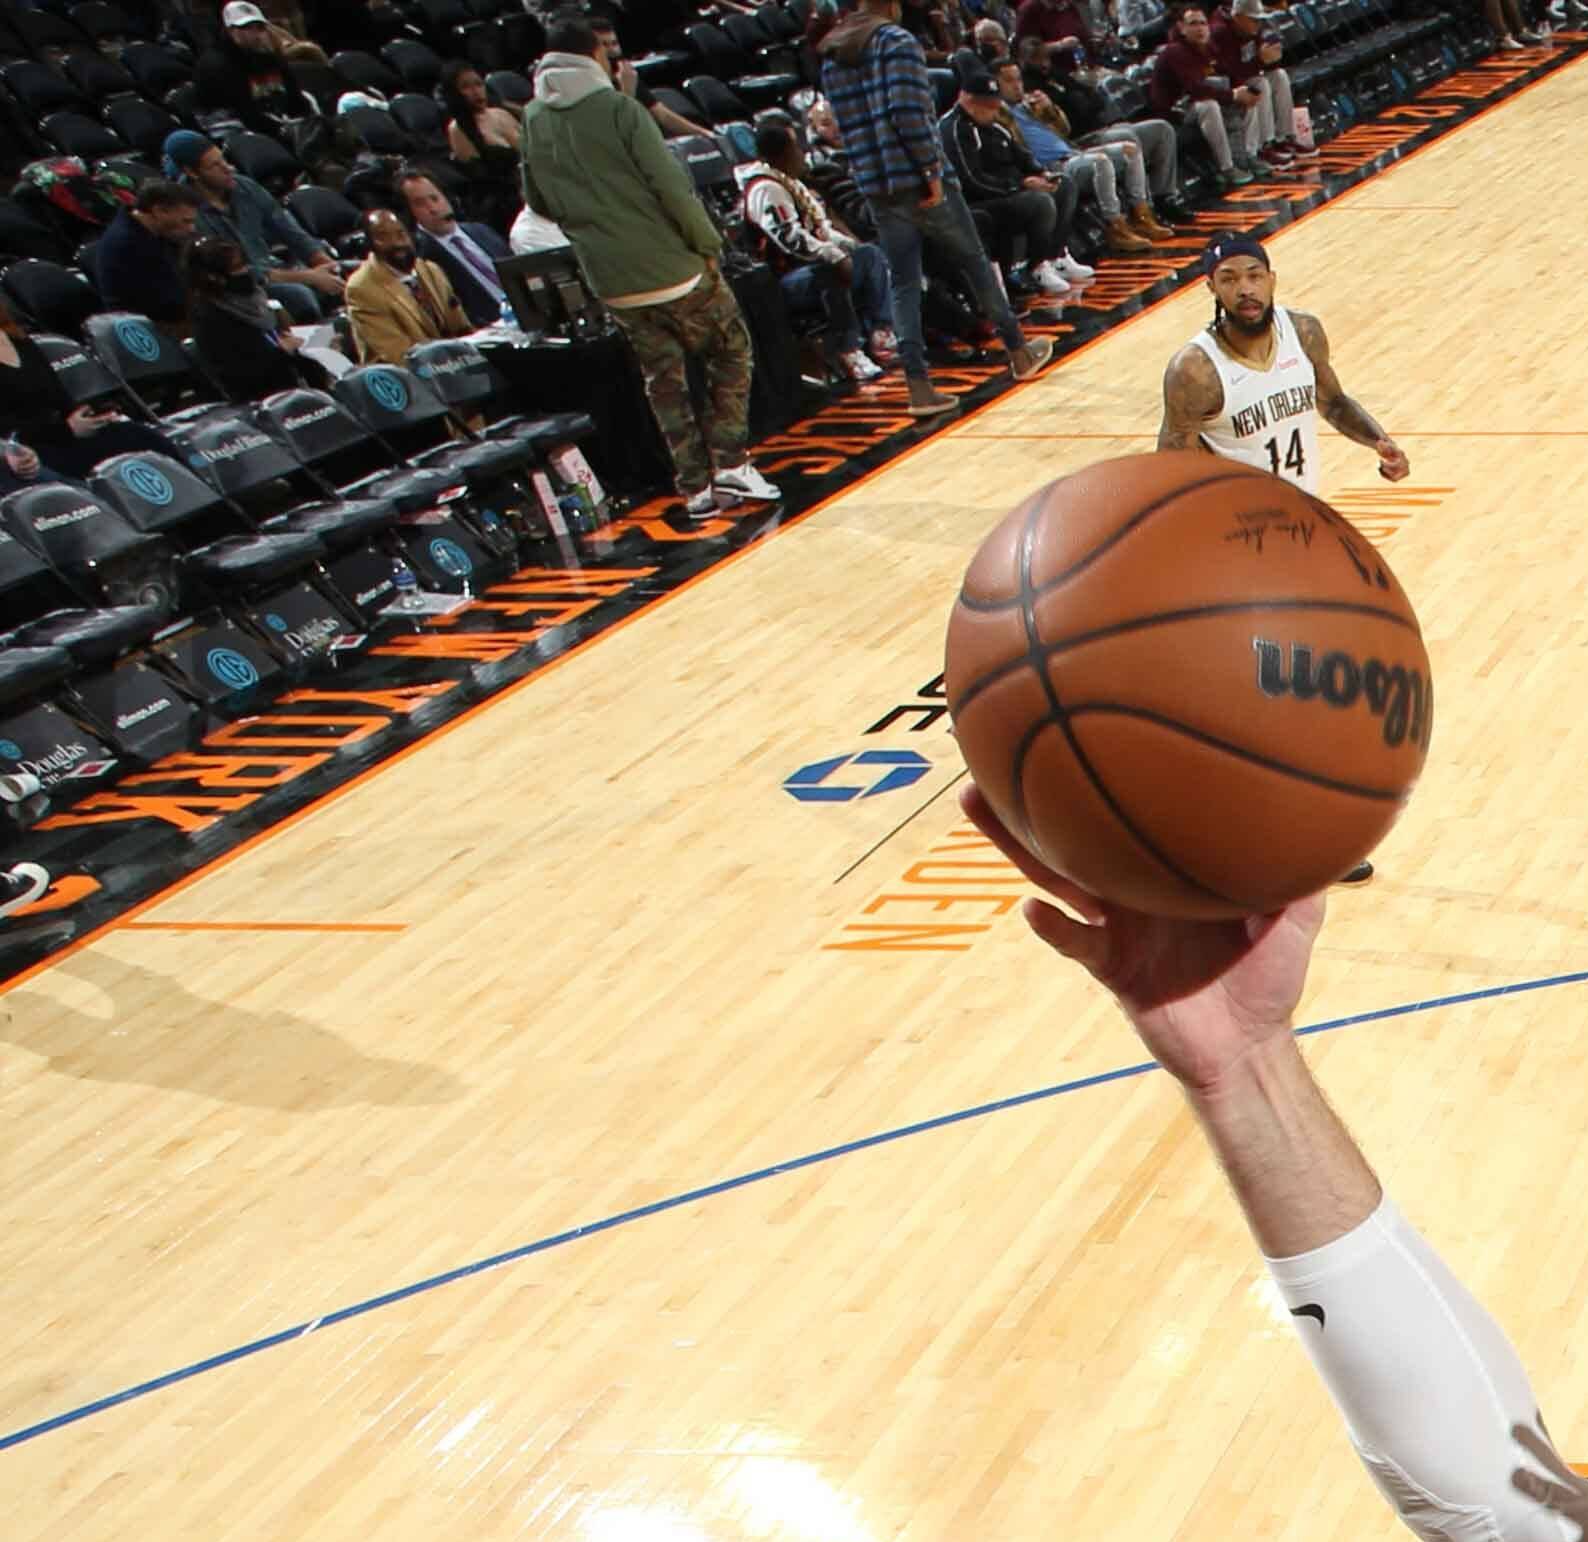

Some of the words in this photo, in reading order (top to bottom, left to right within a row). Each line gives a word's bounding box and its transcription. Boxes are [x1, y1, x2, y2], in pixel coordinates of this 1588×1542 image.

[1231, 402, 1268, 439] NEW
[1267, 383, 1316, 423] ORLEAN
[1263, 427, 1306, 478] 14
[368, 566, 663, 661] NEW
[32, 680, 461, 832] YORK
